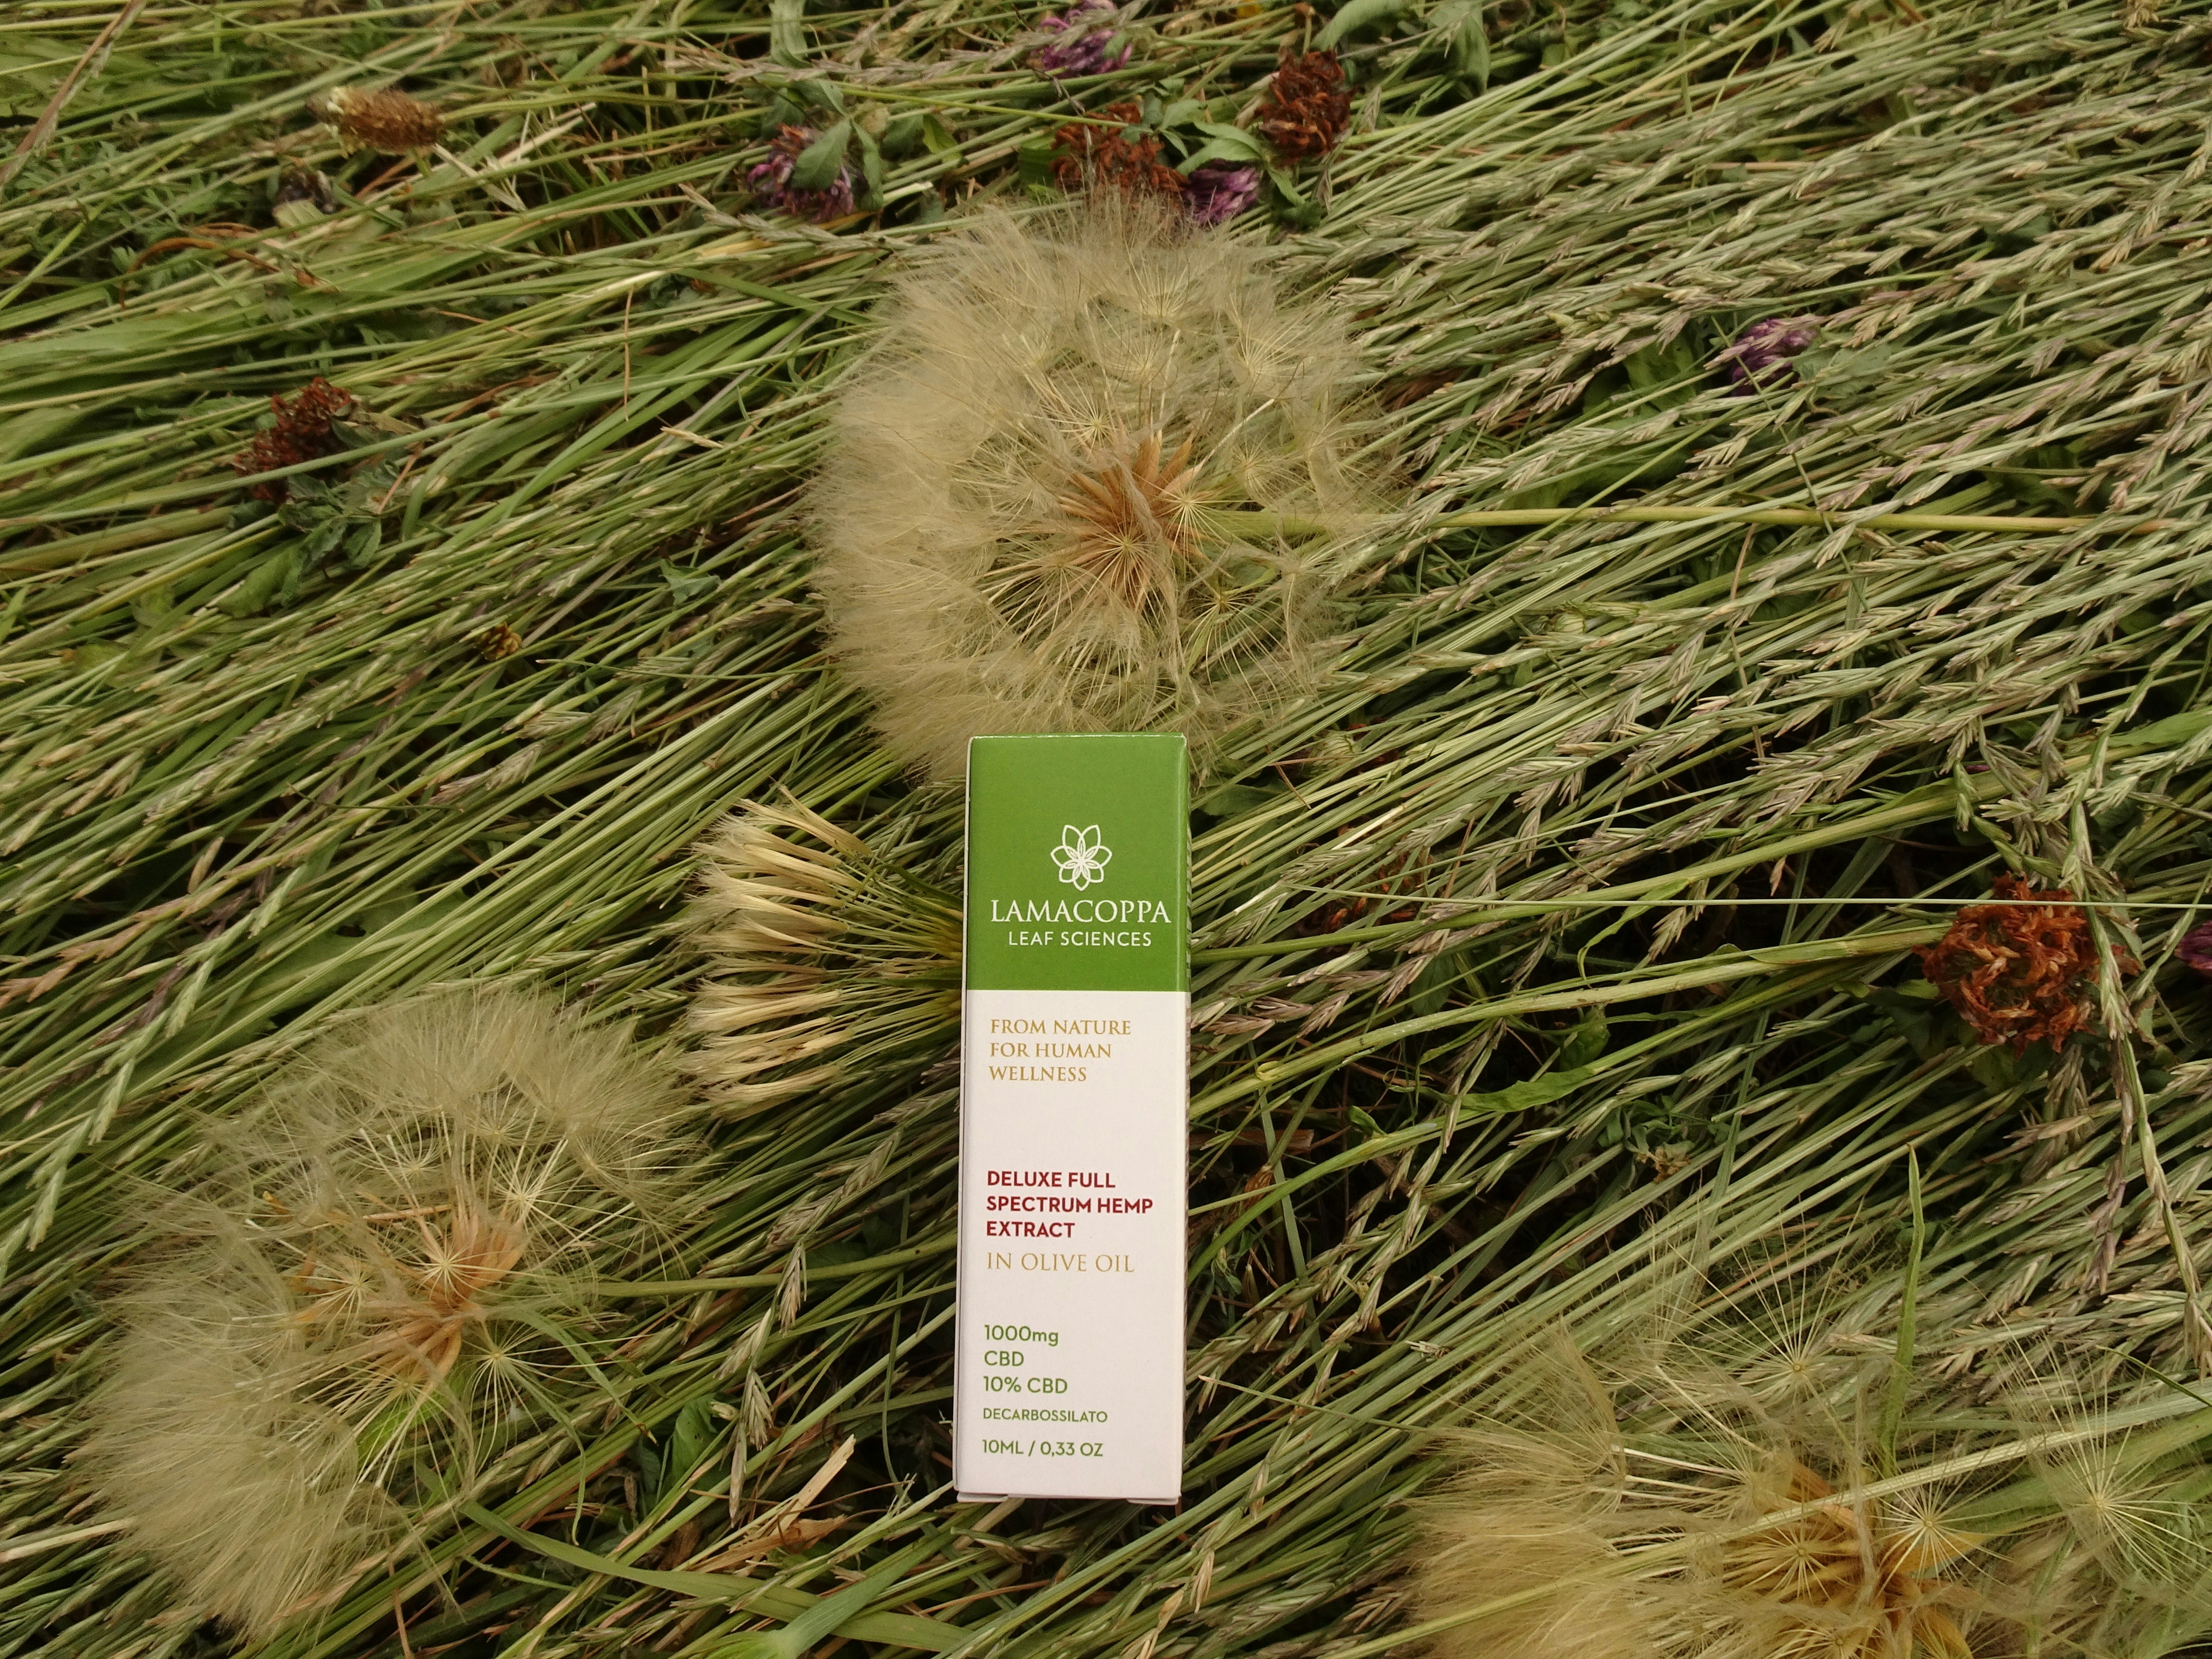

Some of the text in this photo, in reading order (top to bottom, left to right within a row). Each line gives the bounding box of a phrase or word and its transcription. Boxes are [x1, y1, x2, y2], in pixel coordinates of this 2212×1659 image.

[991, 900, 1172, 923] LAMACOPPA
[1009, 931, 1151, 947] LEAF SCIENCES
[991, 1019, 1131, 1035] FROM NATURE
[990, 1042, 1111, 1058] FOR HUMAN
[989, 1066, 1087, 1082] WELLNESS
[988, 1171, 1116, 1188] DELUXE FULL
[986, 1195, 1153, 1214] SPECTRUM HEMP
[987, 1221, 1075, 1238] EXTRACT
[988, 1252, 1134, 1272] IN OLIVE OIL
[984, 1324, 1059, 1347] 1000mg
[984, 1350, 1024, 1367] CBD
[983, 1376, 1068, 1394] 10% CBD
[983, 1407, 1108, 1423] DECARBOSSILATO
[982, 1439, 1103, 1457] 10ML / 0,33 OZ
